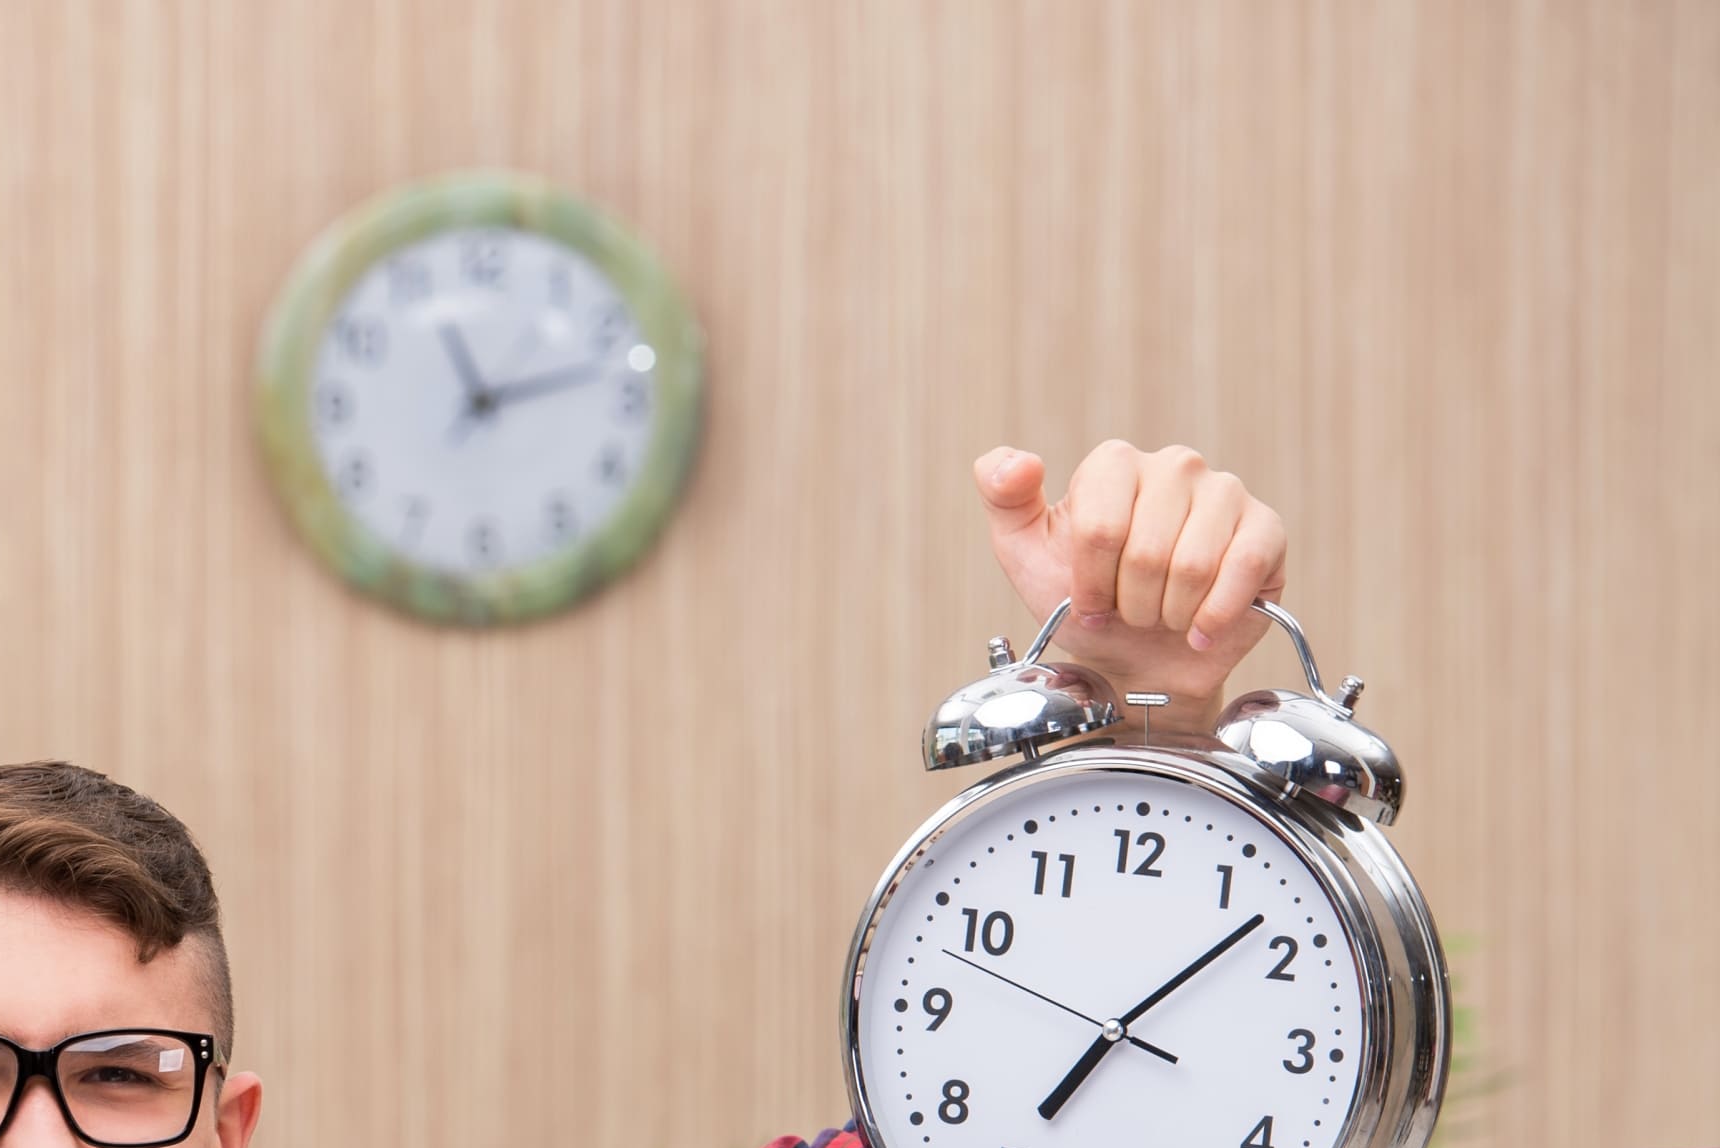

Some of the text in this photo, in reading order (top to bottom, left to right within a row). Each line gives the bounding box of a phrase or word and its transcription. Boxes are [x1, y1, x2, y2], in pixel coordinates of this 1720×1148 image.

[1030, 850, 1076, 898] 11
[1113, 828, 1167, 878] 12
[1215, 864, 1233, 910] 1
[960, 907, 1015, 957] 10
[1264, 935, 1300, 982] 2
[921, 987, 954, 1032] 9
[1282, 1028, 1317, 1075] 3
[937, 1079, 971, 1125] 8
